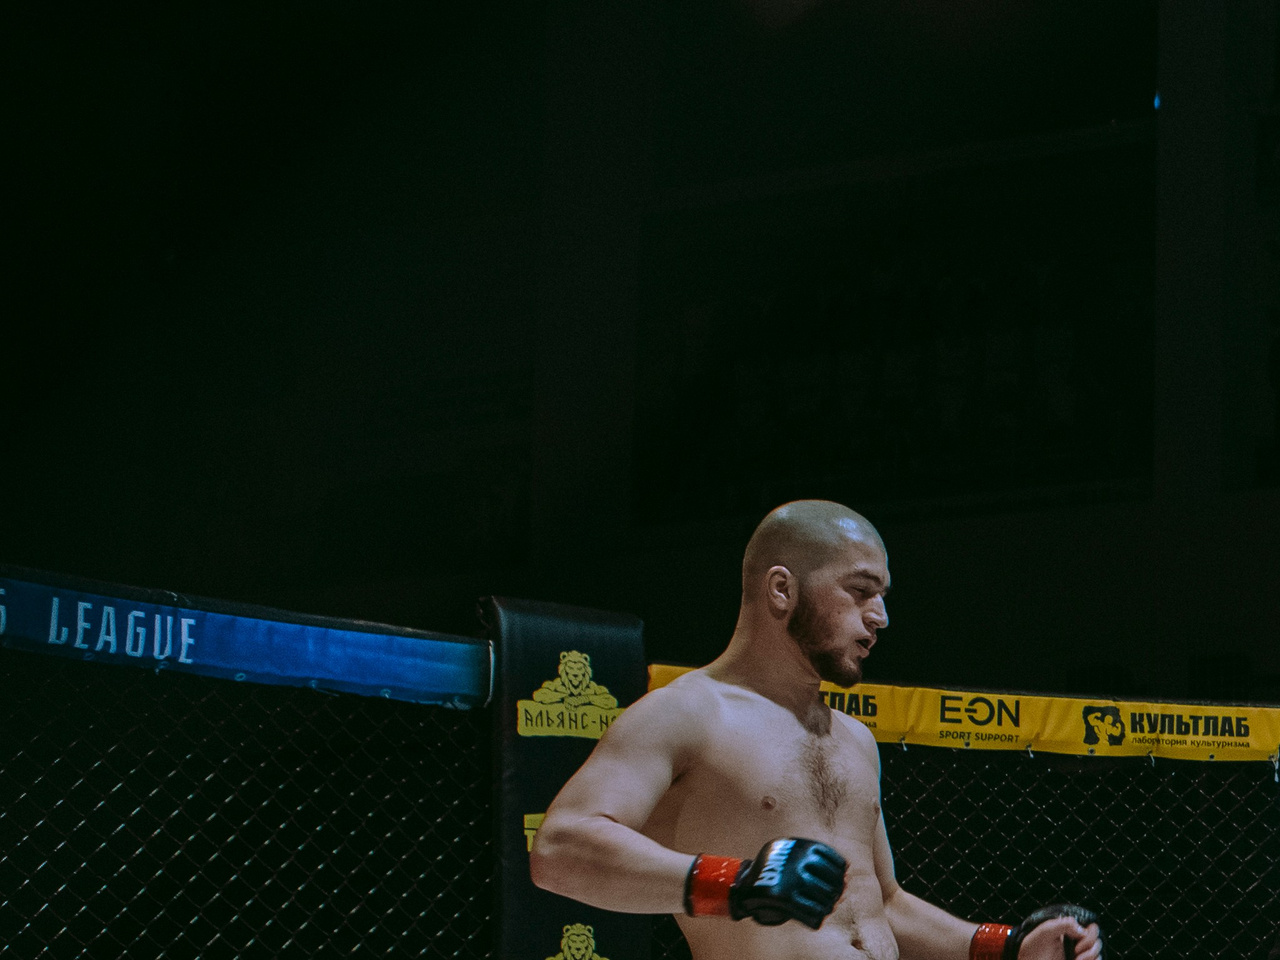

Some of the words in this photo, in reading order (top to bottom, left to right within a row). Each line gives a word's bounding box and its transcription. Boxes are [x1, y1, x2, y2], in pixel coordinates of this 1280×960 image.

[48, 597, 197, 664] LEAGUE
[524, 708, 617, 732] АЛЬЯНС-НС
[940, 695, 1020, 728] EON
[939, 730, 971, 741] SPORT
[975, 732, 1020, 743] SUPPORT
[1130, 712, 1250, 737] КУЛЬТЛАБ
